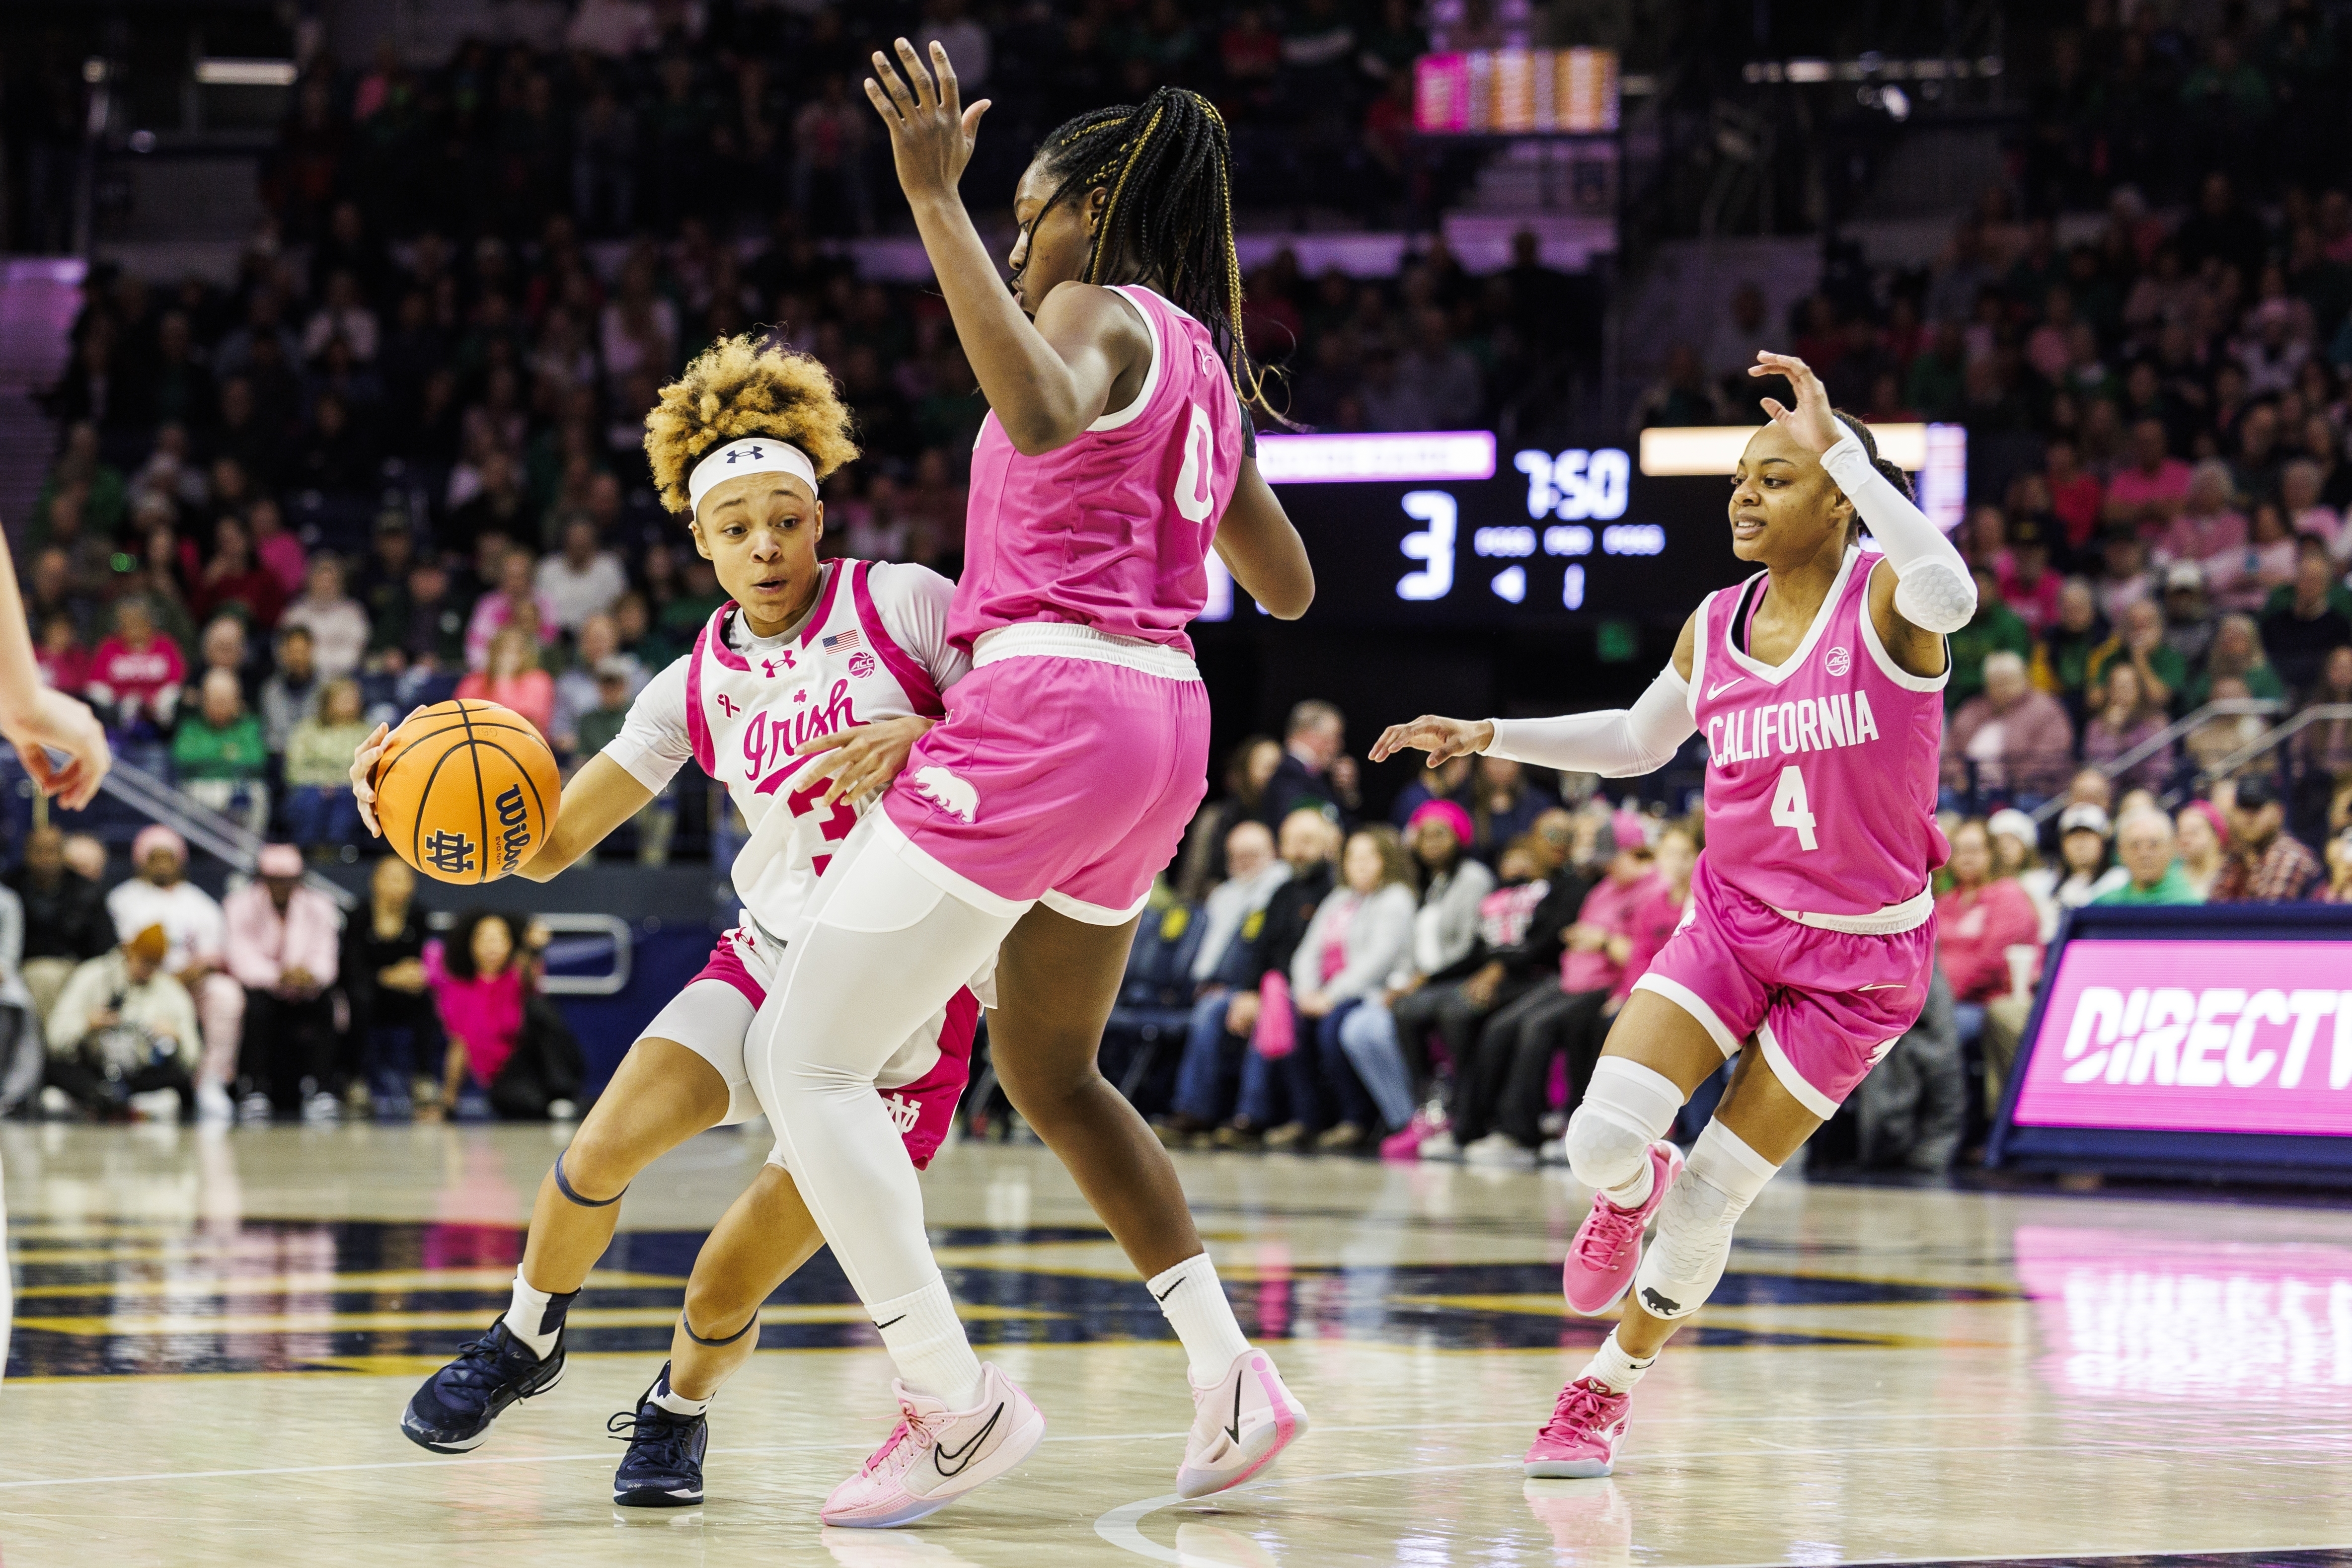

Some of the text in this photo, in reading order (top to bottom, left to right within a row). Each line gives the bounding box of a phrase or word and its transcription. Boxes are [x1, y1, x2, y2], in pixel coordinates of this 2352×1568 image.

[1174, 403, 1214, 523] 0
[1514, 448, 1630, 521] 7:50
[1397, 491, 1457, 600] 3
[851, 657, 875, 670] ACC
[1828, 654, 1849, 665] ACC
[743, 678, 870, 781] Irish
[1707, 690, 1879, 768] CALIFORNIA
[495, 783, 531, 880] Wilso
[1770, 765, 1819, 851] 4
